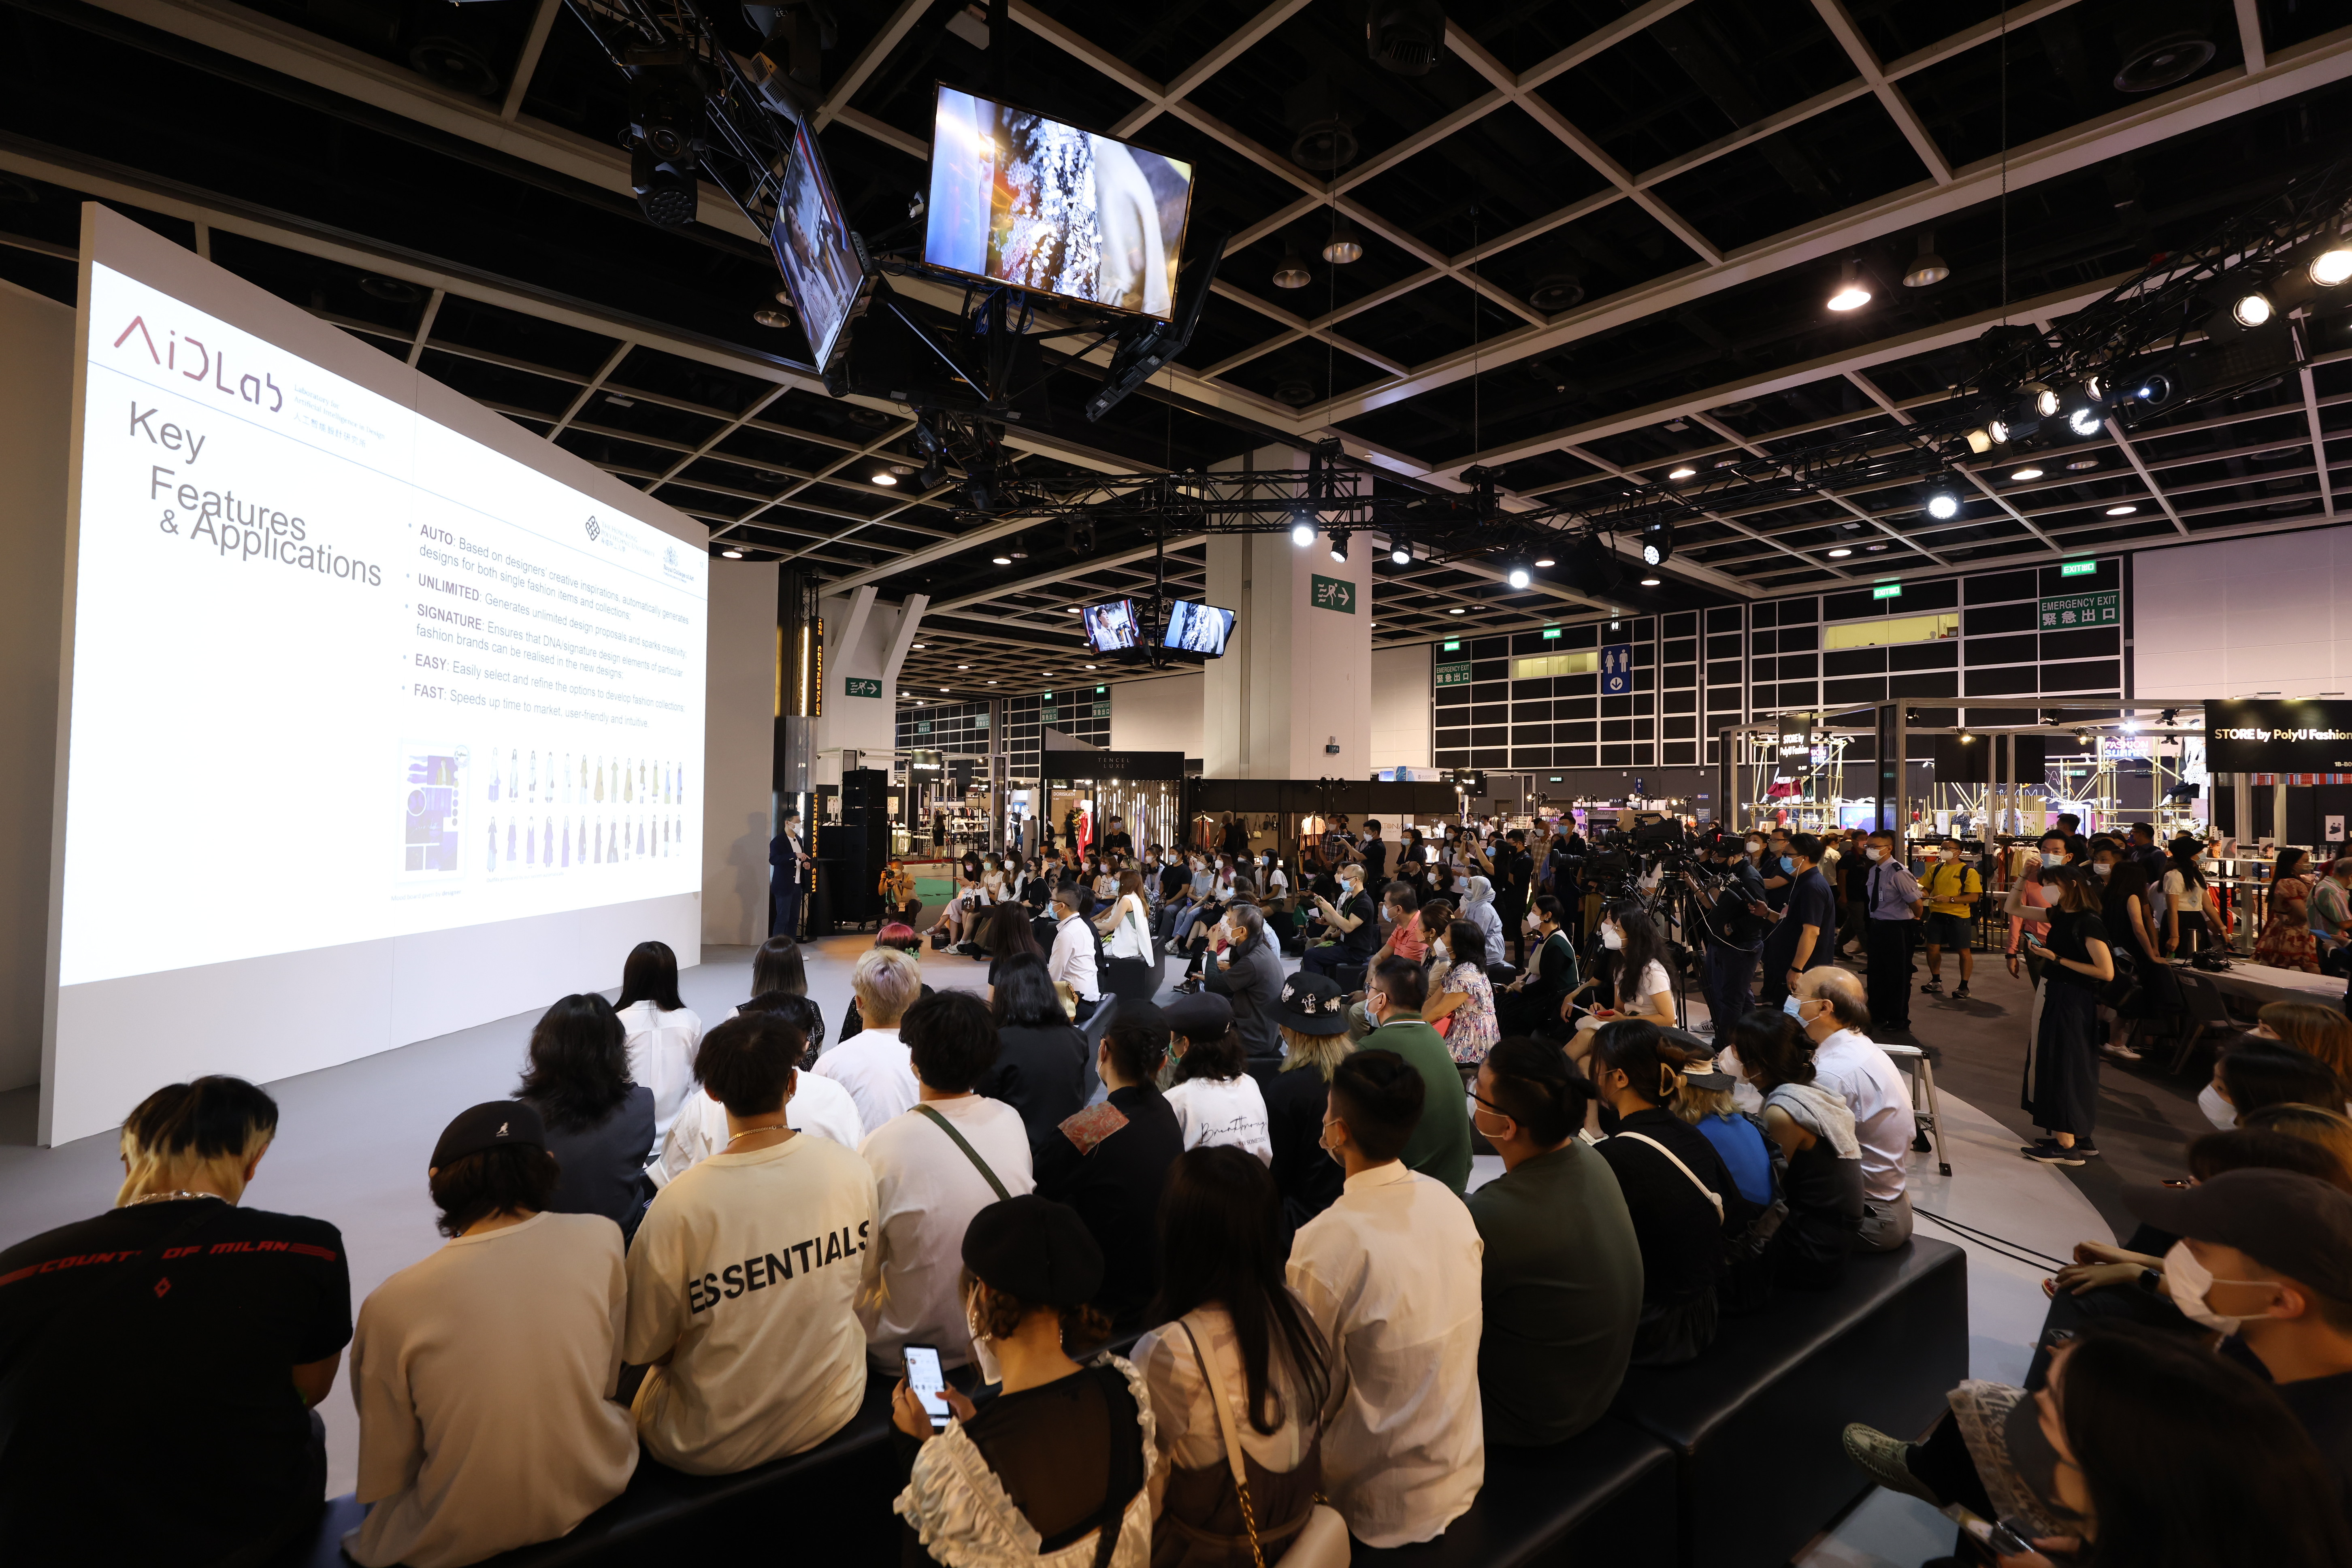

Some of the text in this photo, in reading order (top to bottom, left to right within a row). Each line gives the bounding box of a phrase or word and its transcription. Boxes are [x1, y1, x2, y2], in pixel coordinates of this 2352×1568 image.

[294, 384, 339, 409] Laboratory for
[294, 396, 321, 412] Artificial
[324, 408, 358, 428] Intelligence
[366, 426, 385, 439] Design
[130, 401, 206, 464] Key
[151, 465, 306, 541] Features
[160, 509, 381, 586] & Applications
[420, 524, 455, 547] AUTO:
[459, 537, 488, 558] Based
[492, 552, 502, 562] on
[549, 572, 578, 588] creative
[581, 579, 620, 603] inspirations,
[622, 597, 661, 617] automatically
[663, 610, 689, 624] generates
[420, 544, 631, 622] designs for both single fashion items and collections;
[664, 564, 672, 573] Royal
[673, 569, 685, 578] College
[419, 573, 687, 659] UNLIMITED: Generates unlimited design proposals and sparks creativity;
[2042, 595, 2116, 611] EMERGENCY EXIT
[2043, 608, 2115, 626] 緊急出口
[416, 623, 623, 680] fashion brands can be realised in the new designs;
[417, 603, 683, 677] SIGNATURE: Ensures that DNA/signature design elements of particular
[415, 653, 685, 713] EASY: Easily select and refine the options to develop fashion collections;
[1437, 673, 1469, 683] 緊急出口
[414, 683, 649, 728] FAST: Speeds up time to market, user-friendly and intuitive.
[1780, 745, 1809, 757] PolyU Fashion
[1783, 733, 1804, 744] STORE by
[2215, 728, 2352, 742] STORE by PolyU Fashion
[1246, 1136, 1266, 1145] SOMETHING
[161, 1244, 203, 1259] OF
[209, 1241, 291, 1255] MILAN
[690, 1220, 869, 1315] ESSENTIALS
